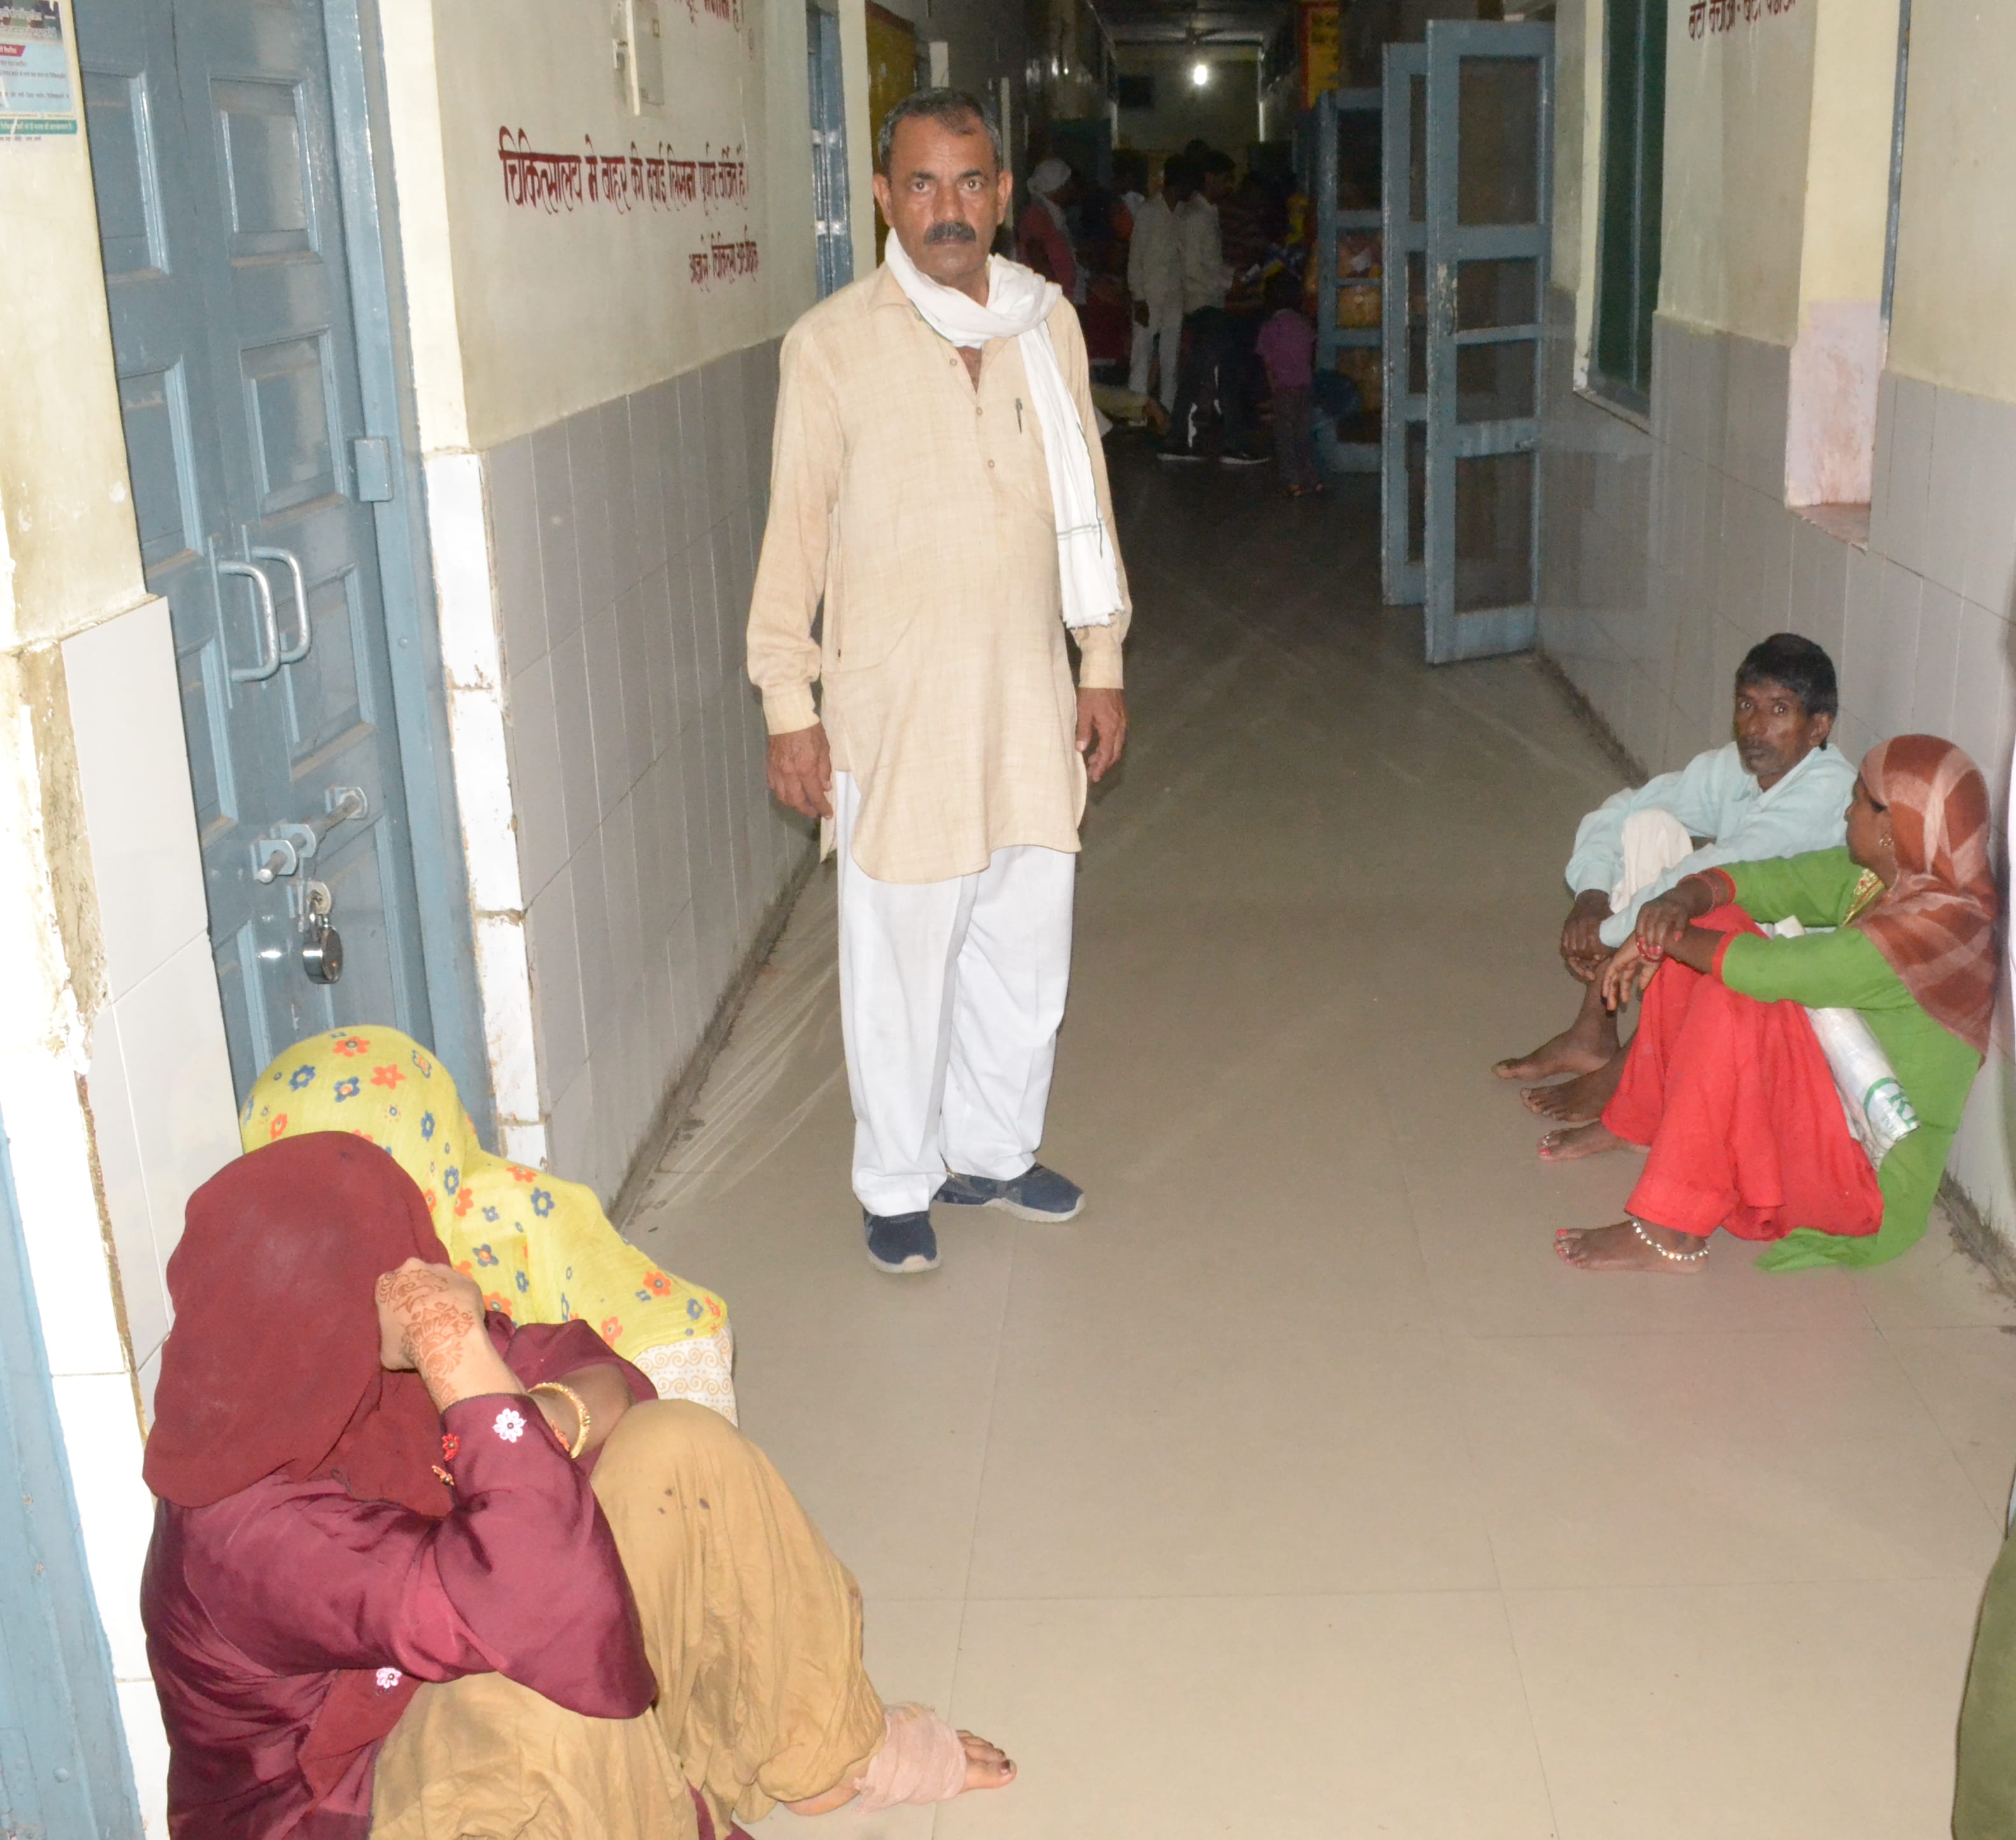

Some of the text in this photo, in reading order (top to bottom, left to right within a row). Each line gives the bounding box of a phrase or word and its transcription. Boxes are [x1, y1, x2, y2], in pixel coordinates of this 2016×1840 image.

[1689, 0, 1706, 40] बटी
[498, 125, 583, 215] चिकित्सालय
[600, 155, 631, 214] बाहर
